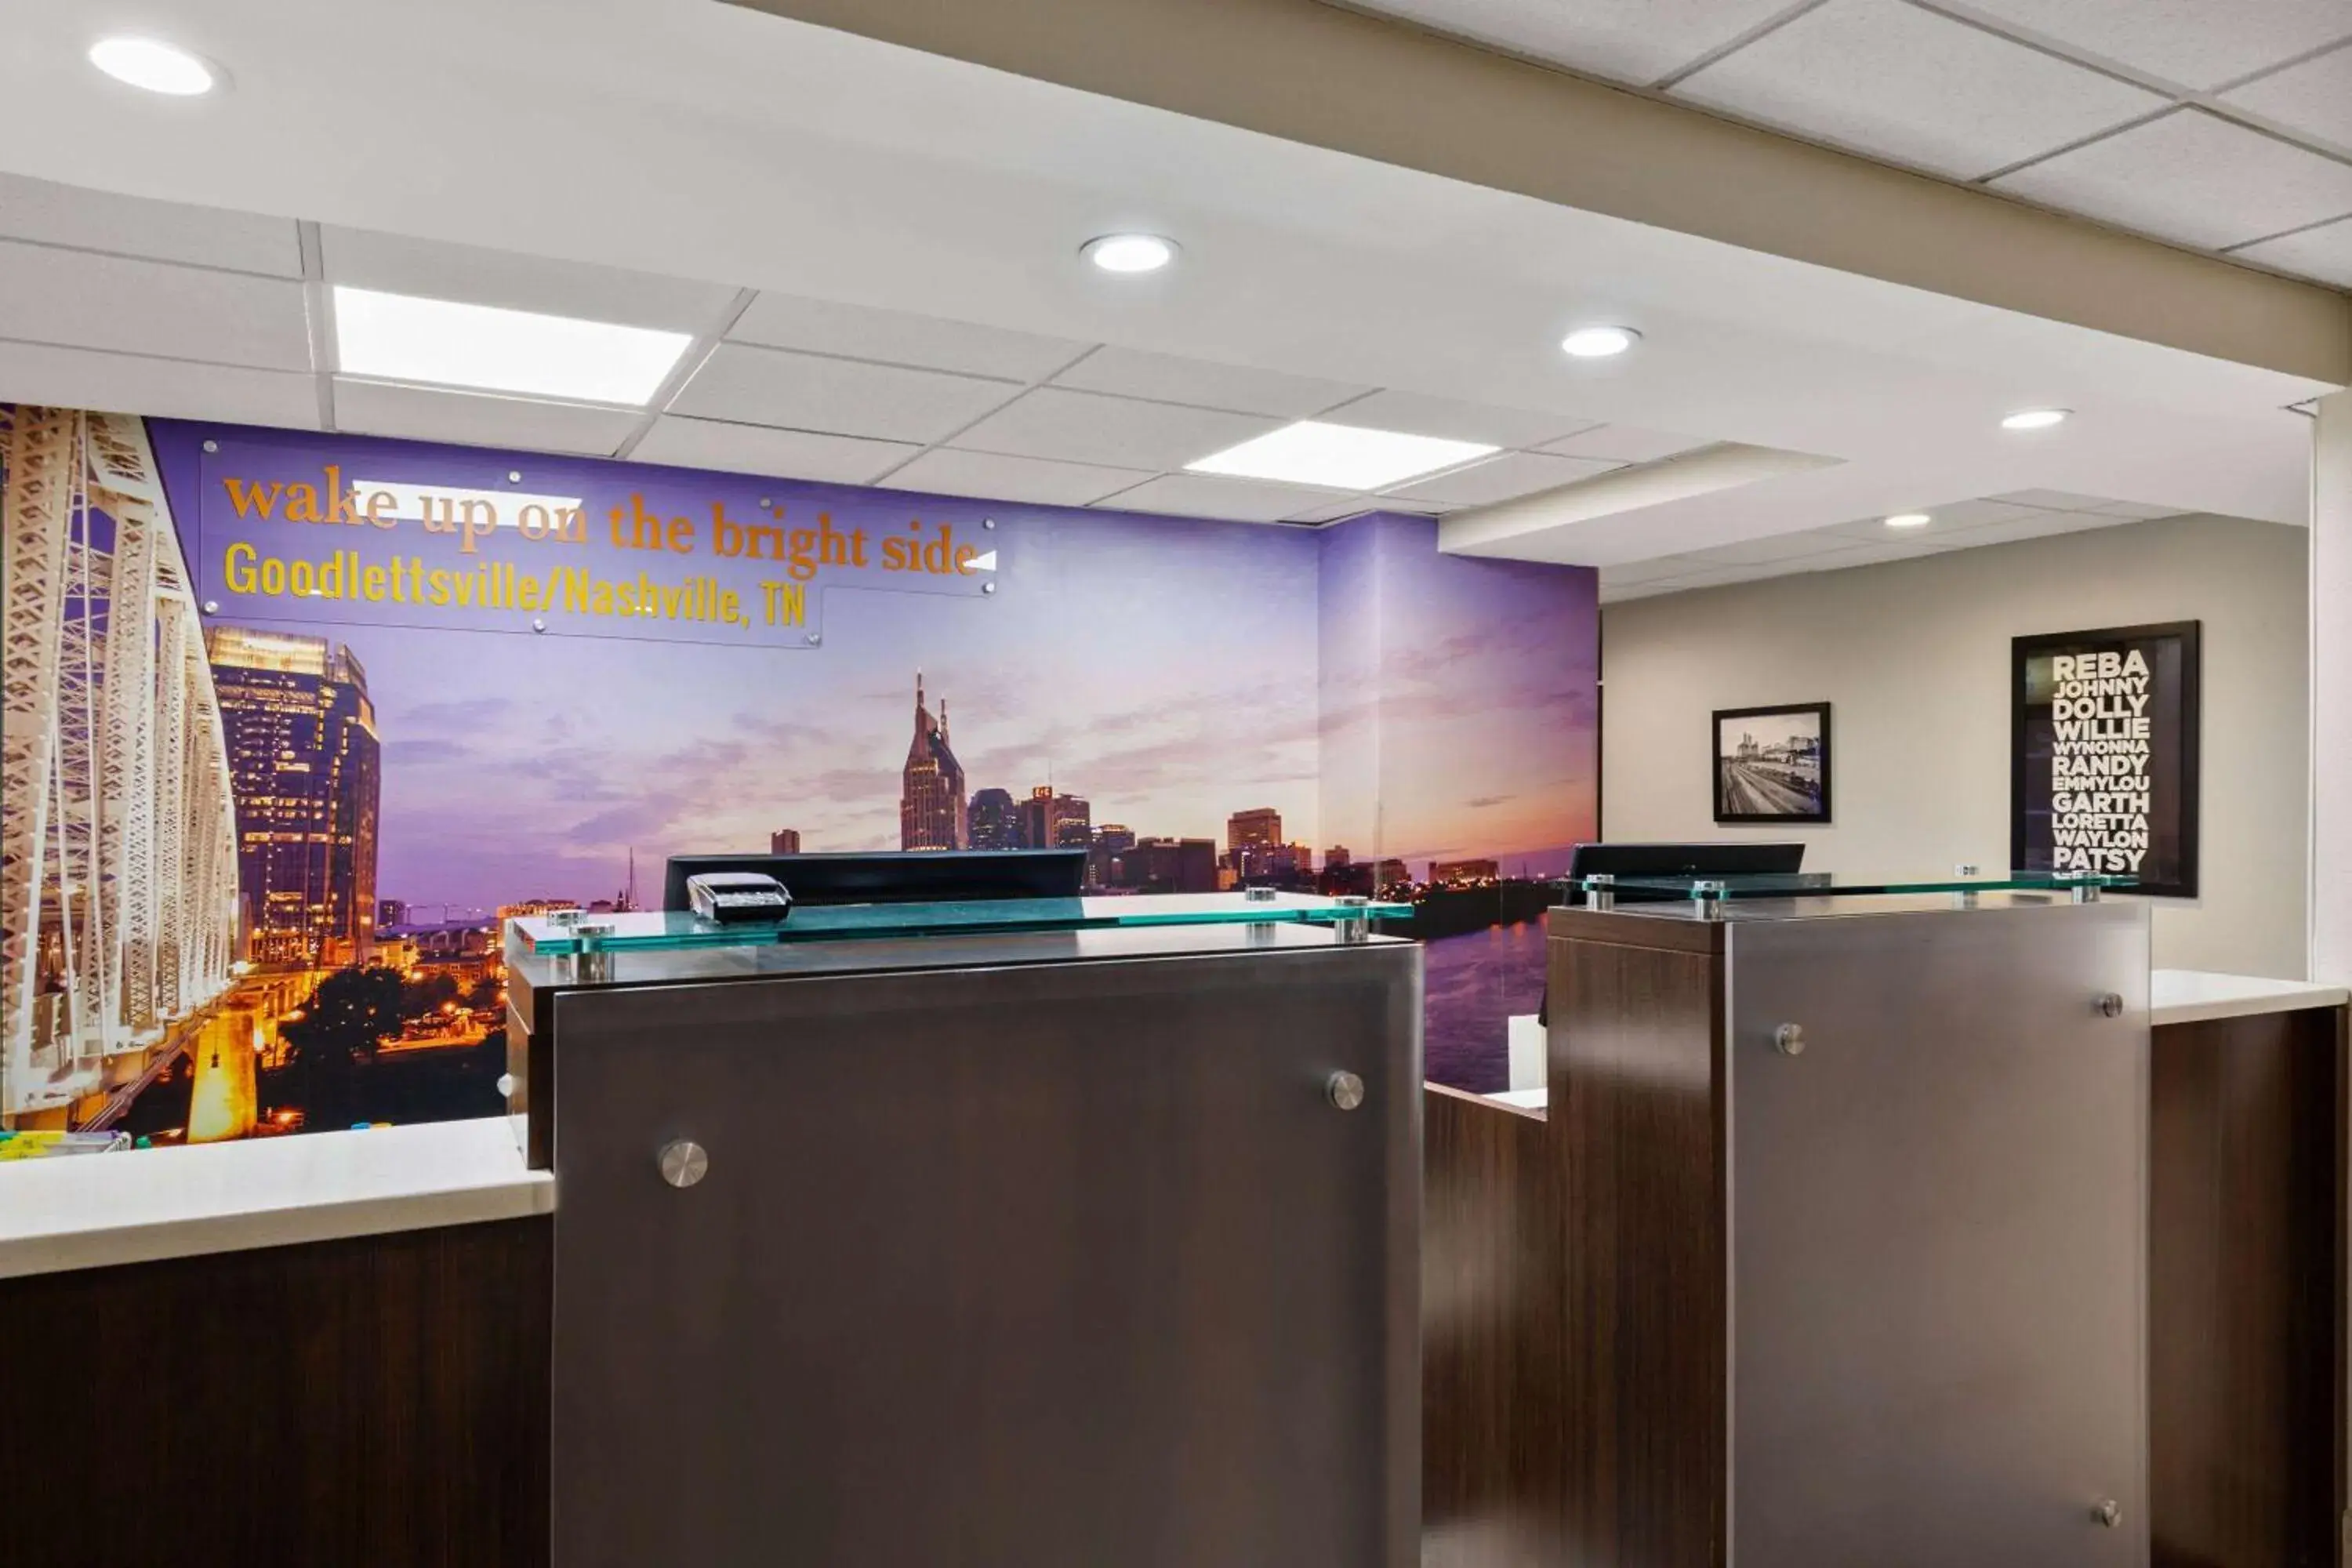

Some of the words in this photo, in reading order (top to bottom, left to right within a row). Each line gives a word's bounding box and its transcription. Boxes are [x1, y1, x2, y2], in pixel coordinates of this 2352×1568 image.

[223, 464, 398, 529] wake
[418, 494, 498, 554] up
[518, 500, 587, 544] on
[607, 492, 695, 554] the
[710, 501, 869, 581] bright
[882, 520, 978, 575] side
[224, 542, 750, 630] Goodlettsville/Nashville,
[760, 581, 806, 626] TN
[2052, 649, 2149, 681] REBA
[2053, 677, 2149, 699] JOHNNY
[2052, 694, 2149, 720] DOLLY
[2053, 717, 2149, 741] WILLIE
[2053, 739, 2149, 755] WYNONNA
[2052, 753, 2149, 777] RANDY
[2052, 775, 2149, 791] EMMYLOU
[2052, 791, 2149, 813] GARTH
[2052, 812, 2149, 830] LORETTA
[2053, 829, 2149, 848] WAYLON
[2053, 847, 2147, 873] PATSY
